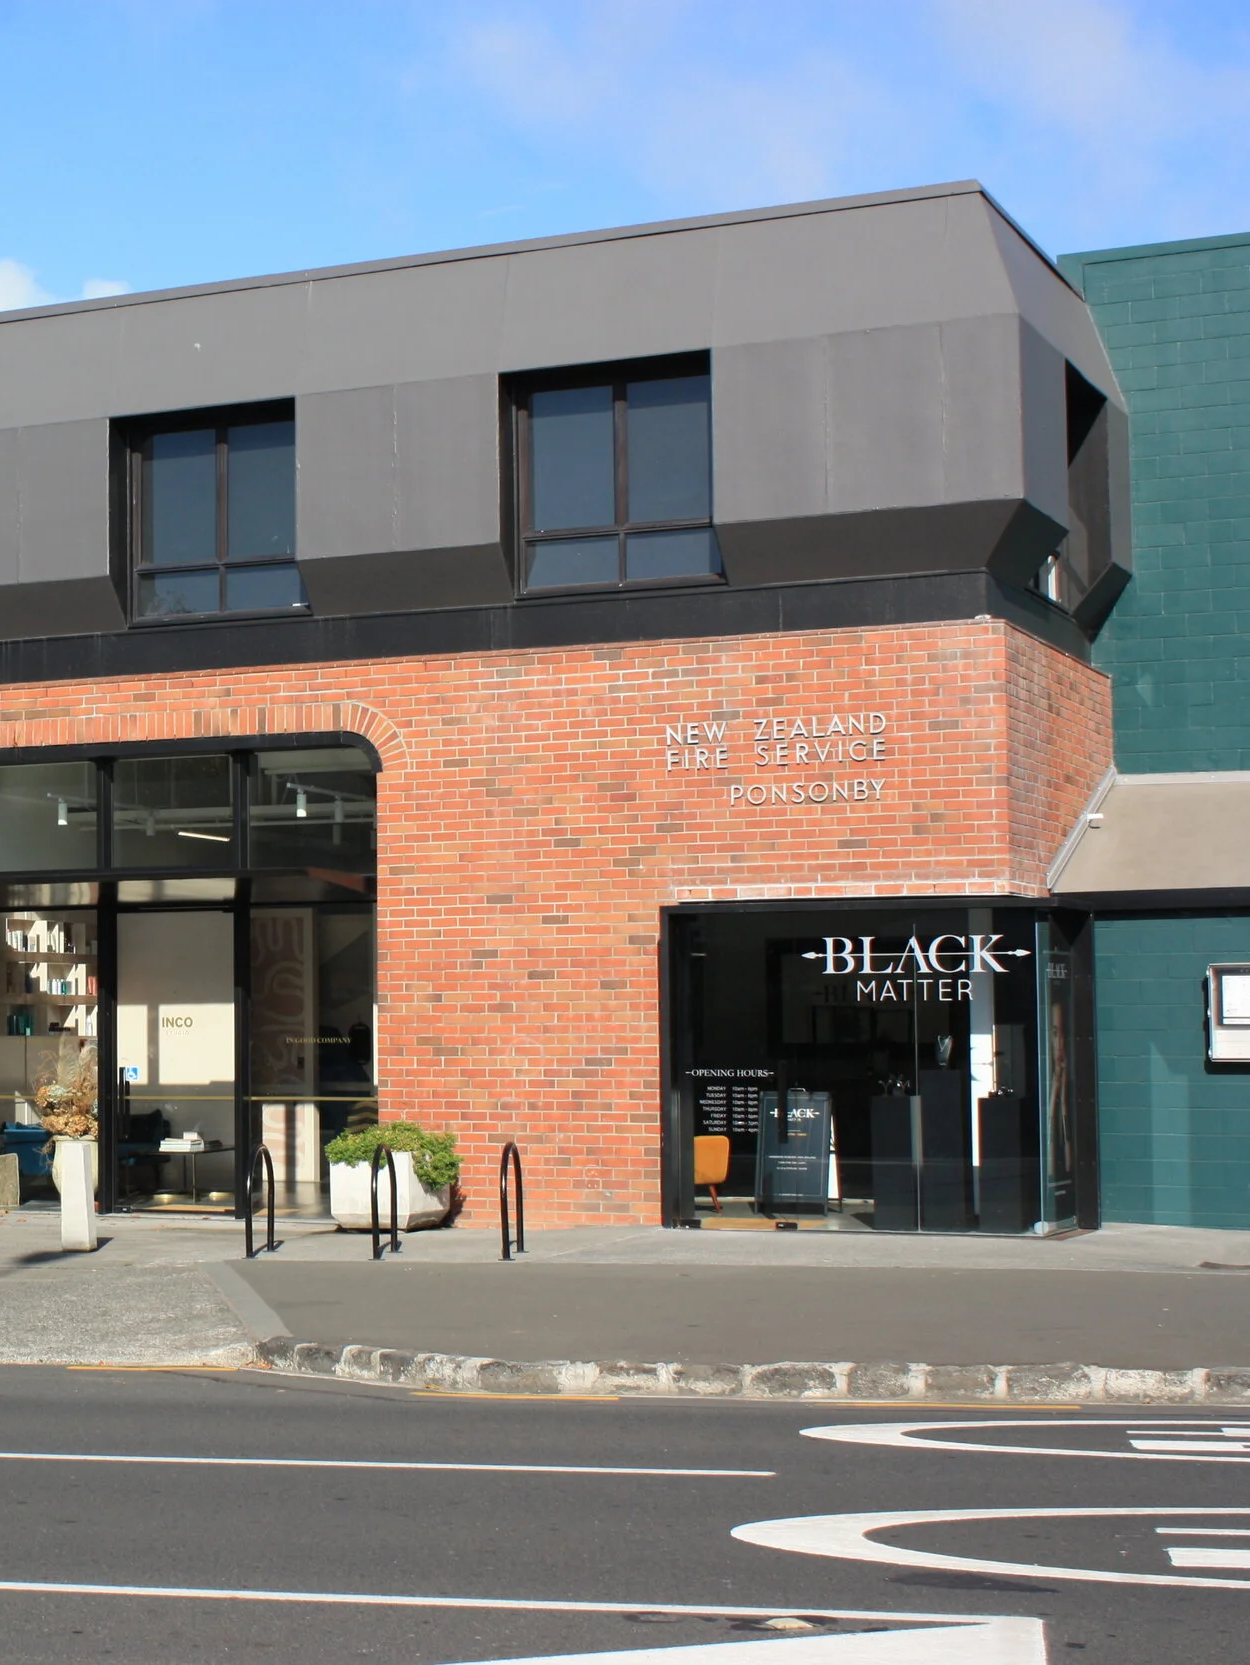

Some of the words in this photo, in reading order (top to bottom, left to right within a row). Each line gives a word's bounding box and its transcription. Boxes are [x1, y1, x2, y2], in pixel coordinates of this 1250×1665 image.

[666, 721, 727, 746] NEW
[753, 713, 887, 741] ZEALAND
[666, 747, 729, 772] FIRE
[754, 738, 887, 766] SERVICE
[730, 778, 887, 806] PONSONBY
[821, 934, 1011, 975] BLACK
[856, 979, 974, 1001] MATTER
[161, 1016, 193, 1028] INCO
[691, 1068, 735, 1077] OPENING
[736, 1069, 769, 1077] HOURS
